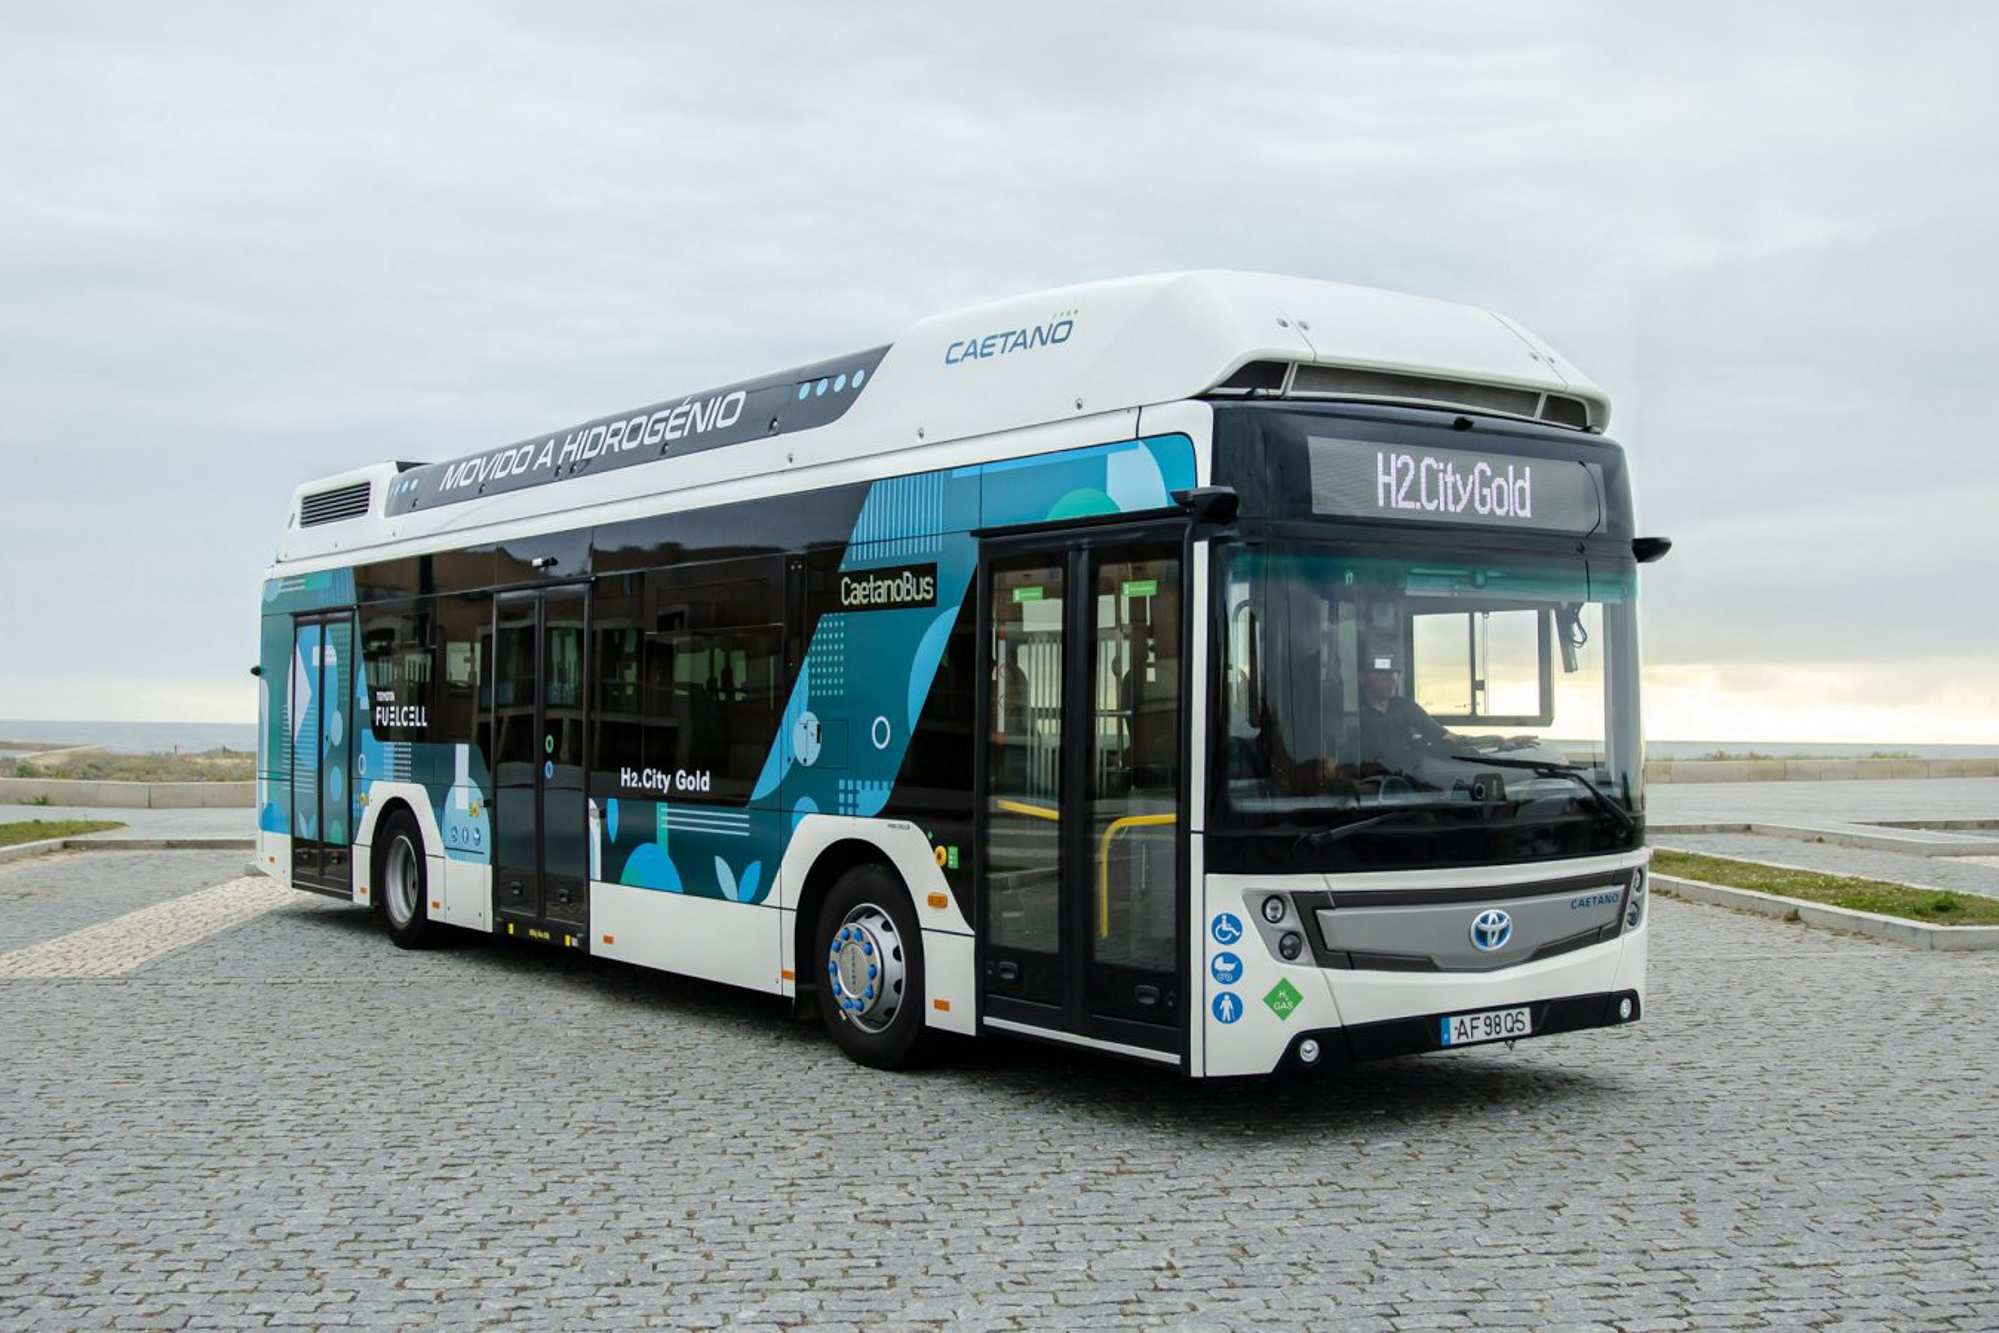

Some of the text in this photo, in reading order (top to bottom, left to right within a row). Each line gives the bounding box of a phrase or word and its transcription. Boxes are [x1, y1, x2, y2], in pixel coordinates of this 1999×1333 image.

[945, 319, 1073, 364] CAETANO
[438, 390, 747, 491] MOVIDO A HIDROGÉNIO
[841, 571, 934, 606] CaetanoBus
[620, 766, 710, 794] H2.City Gold
[1571, 893, 1619, 909] CAETANO
[1273, 1001, 1294, 1010] GAS
